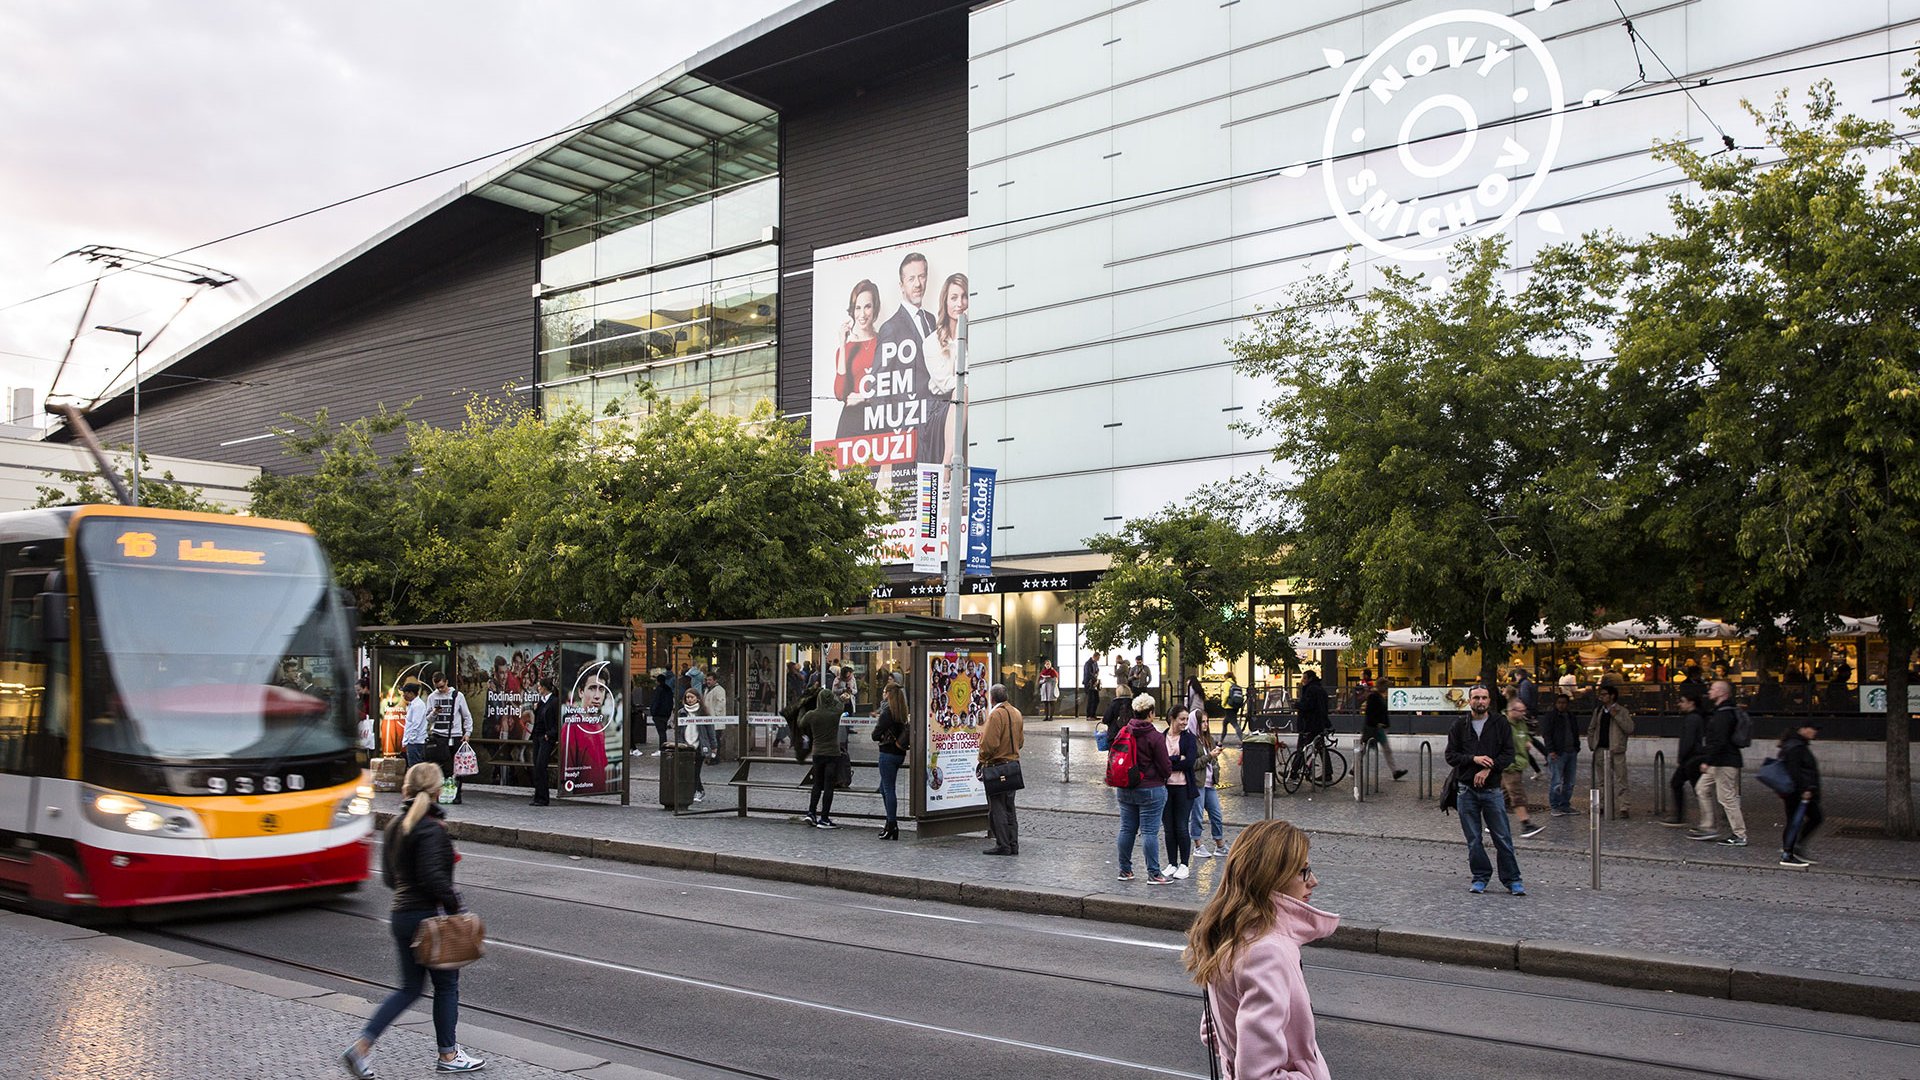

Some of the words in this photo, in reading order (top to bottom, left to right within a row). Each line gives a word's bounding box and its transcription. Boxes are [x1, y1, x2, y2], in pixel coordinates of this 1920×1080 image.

[1369, 36, 1511, 105] NOVÝ
[1347, 136, 1530, 239] SMÍCHOV
[881, 339, 917, 367] PO
[859, 367, 914, 399] ČEM
[864, 393, 927, 431] MUŽI
[838, 426, 914, 465] TOUŽÍ
[971, 477, 989, 522] Čedok
[117, 531, 157, 558] 16
[871, 588, 893, 598] PLAY
[972, 583, 996, 594] PLAY
[488, 690, 523, 703] Rodinám,
[524, 690, 540, 702] těm
[488, 706, 494, 717] je
[496, 705, 509, 715] teď
[510, 705, 522, 718] hej
[207, 773, 305, 794] 9380
